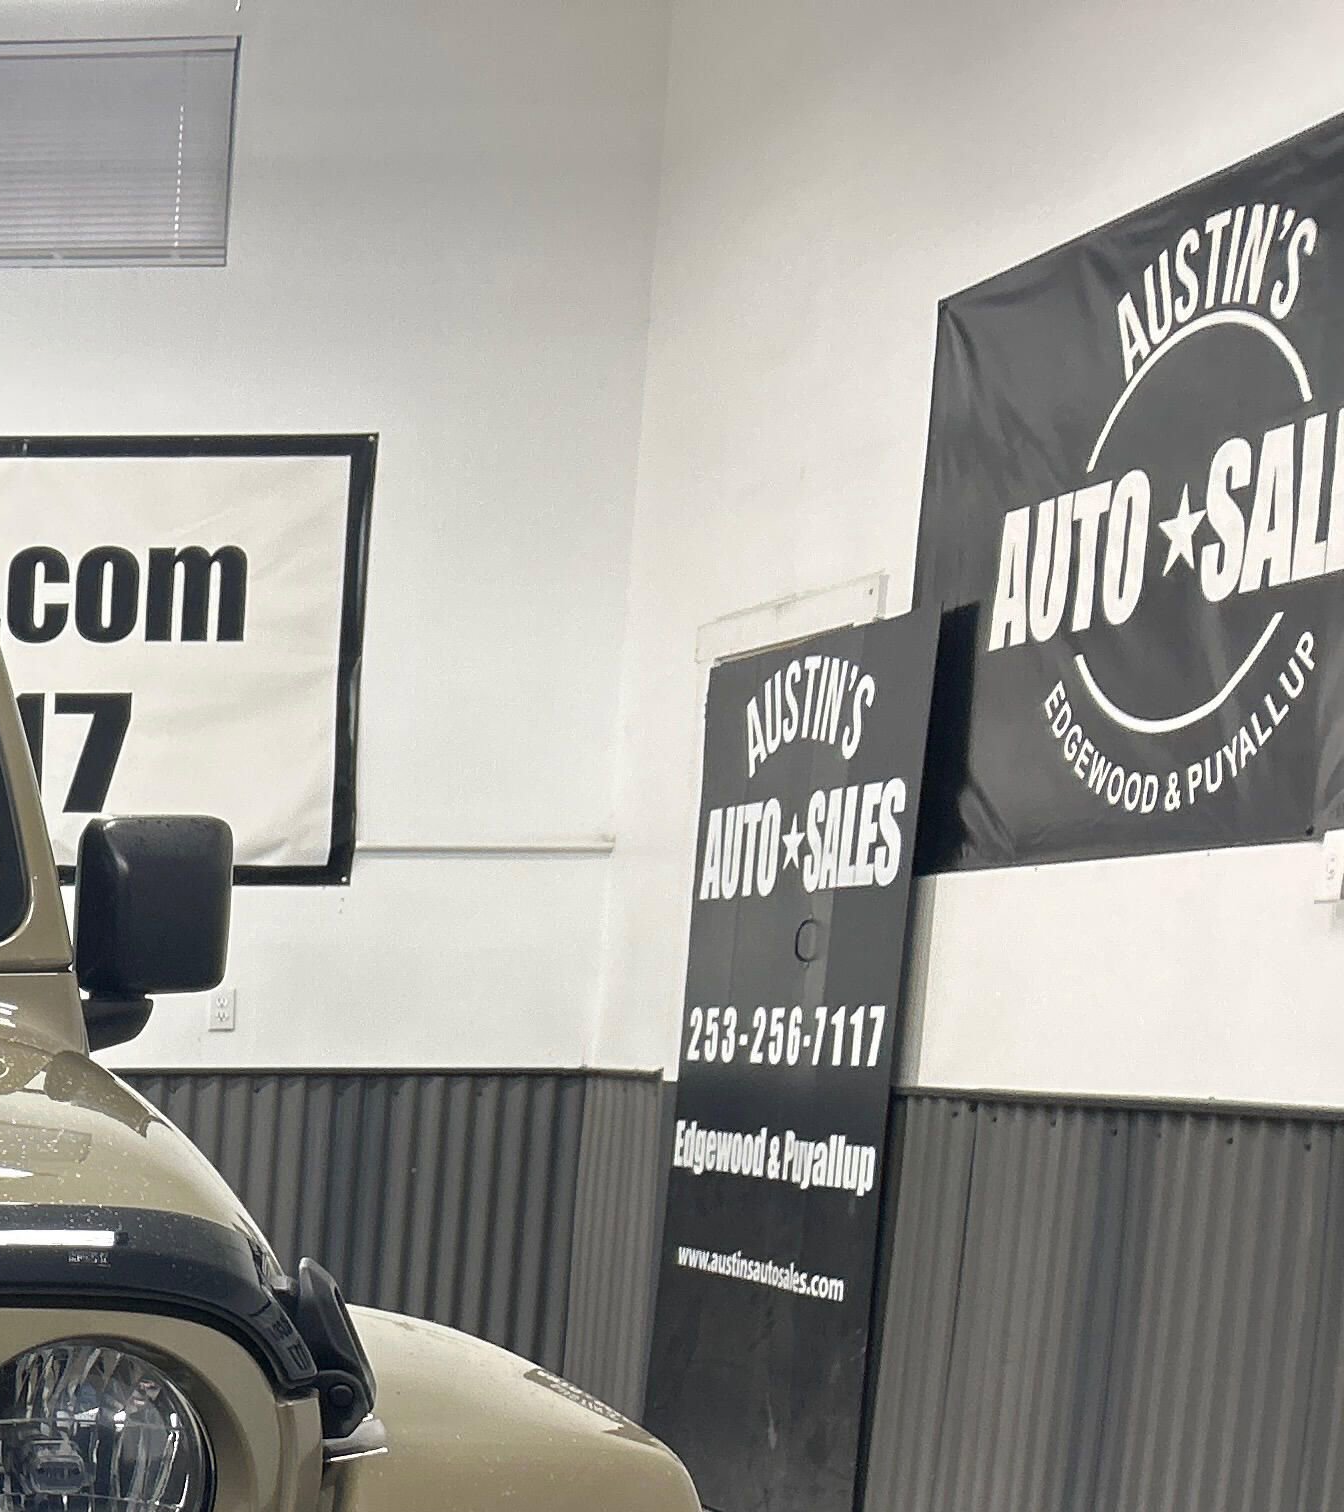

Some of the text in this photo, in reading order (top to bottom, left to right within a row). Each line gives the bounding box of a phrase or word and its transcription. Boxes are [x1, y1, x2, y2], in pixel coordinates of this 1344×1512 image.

[1116, 203, 1316, 381] AUSTIN'S
[988, 468, 1150, 652] AUTO
[746, 655, 876, 779] AUSTIN'S
[1043, 631, 1316, 814] EDGEWOOD & PUYALLUP
[699, 777, 907, 900] AUTO SALES
[686, 1005, 886, 1067] 253-256-7117
[673, 1120, 877, 1197] Edgewood & Puyallup
[677, 1246, 845, 1302] www.austinsautosales.com
